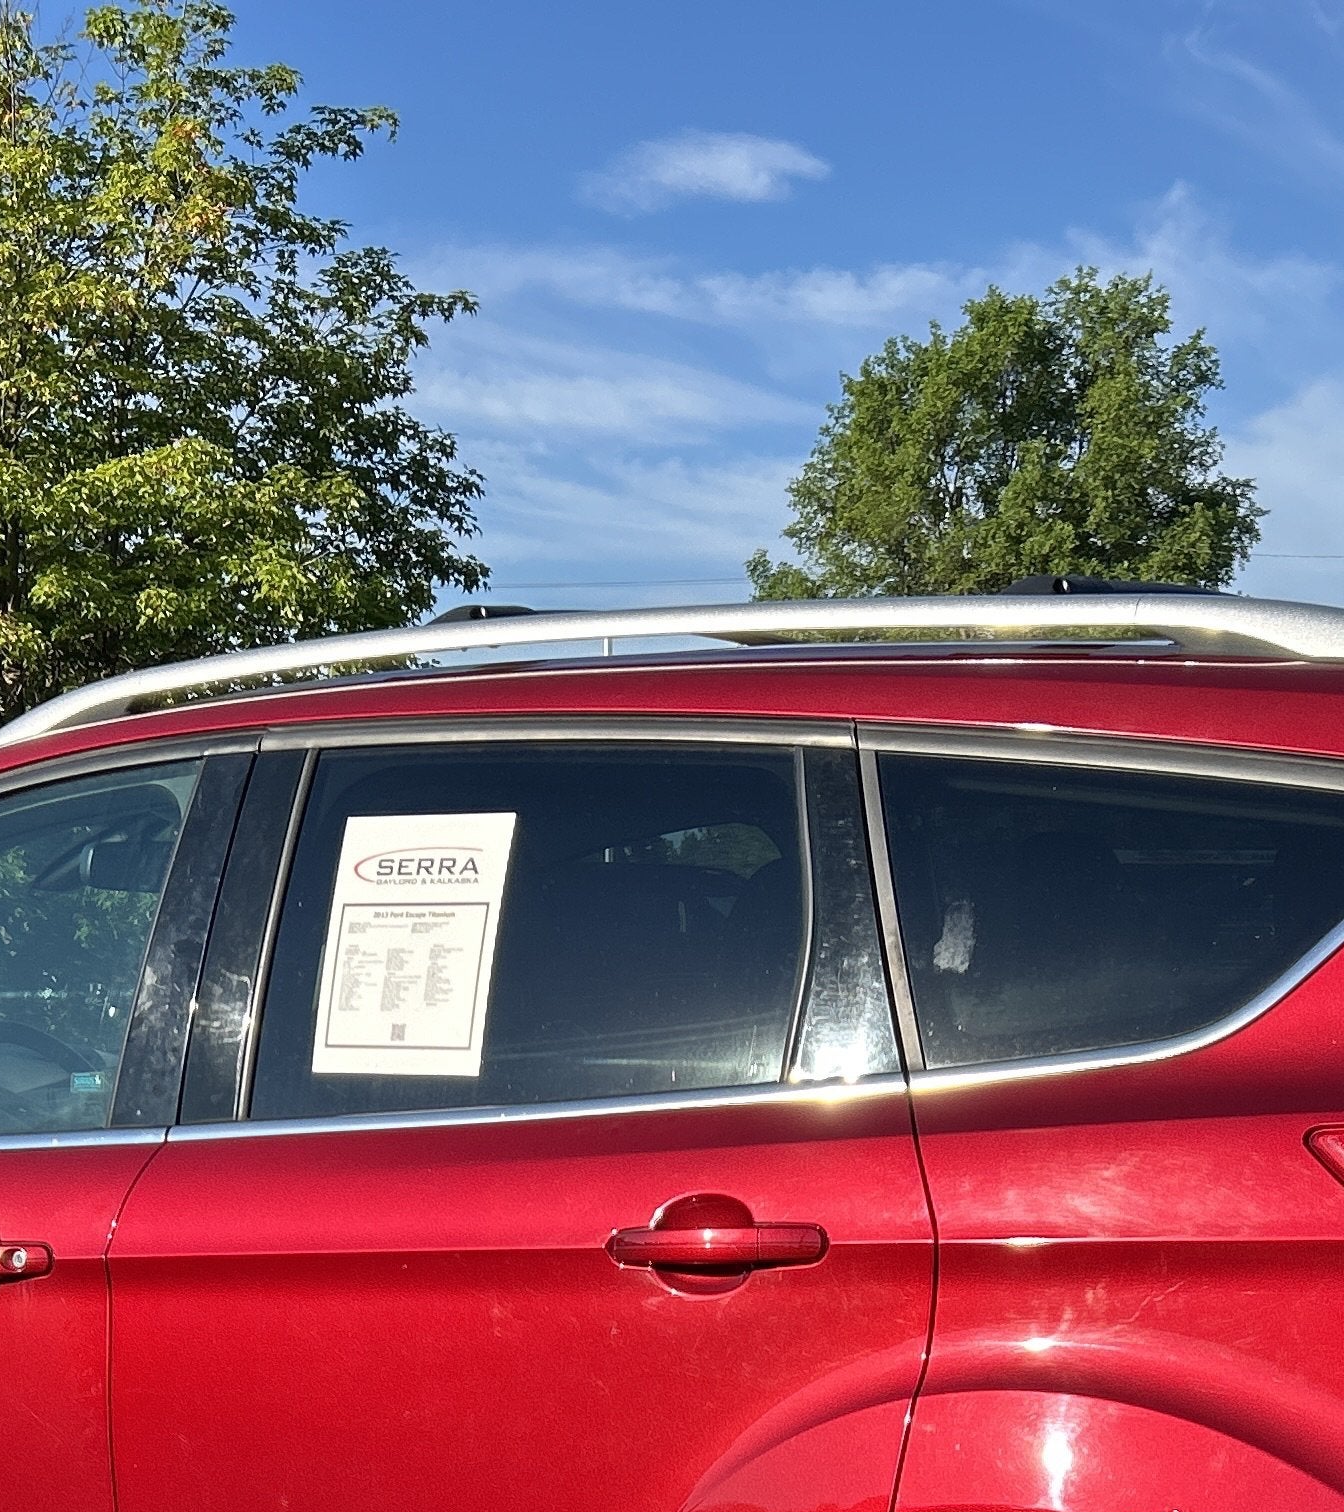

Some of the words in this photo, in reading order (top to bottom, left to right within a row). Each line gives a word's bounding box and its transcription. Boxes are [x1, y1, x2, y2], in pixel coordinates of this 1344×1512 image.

[376, 857, 479, 876] SERRA
[429, 877, 479, 885] KALKASKA
[405, 911, 426, 919] Escape
